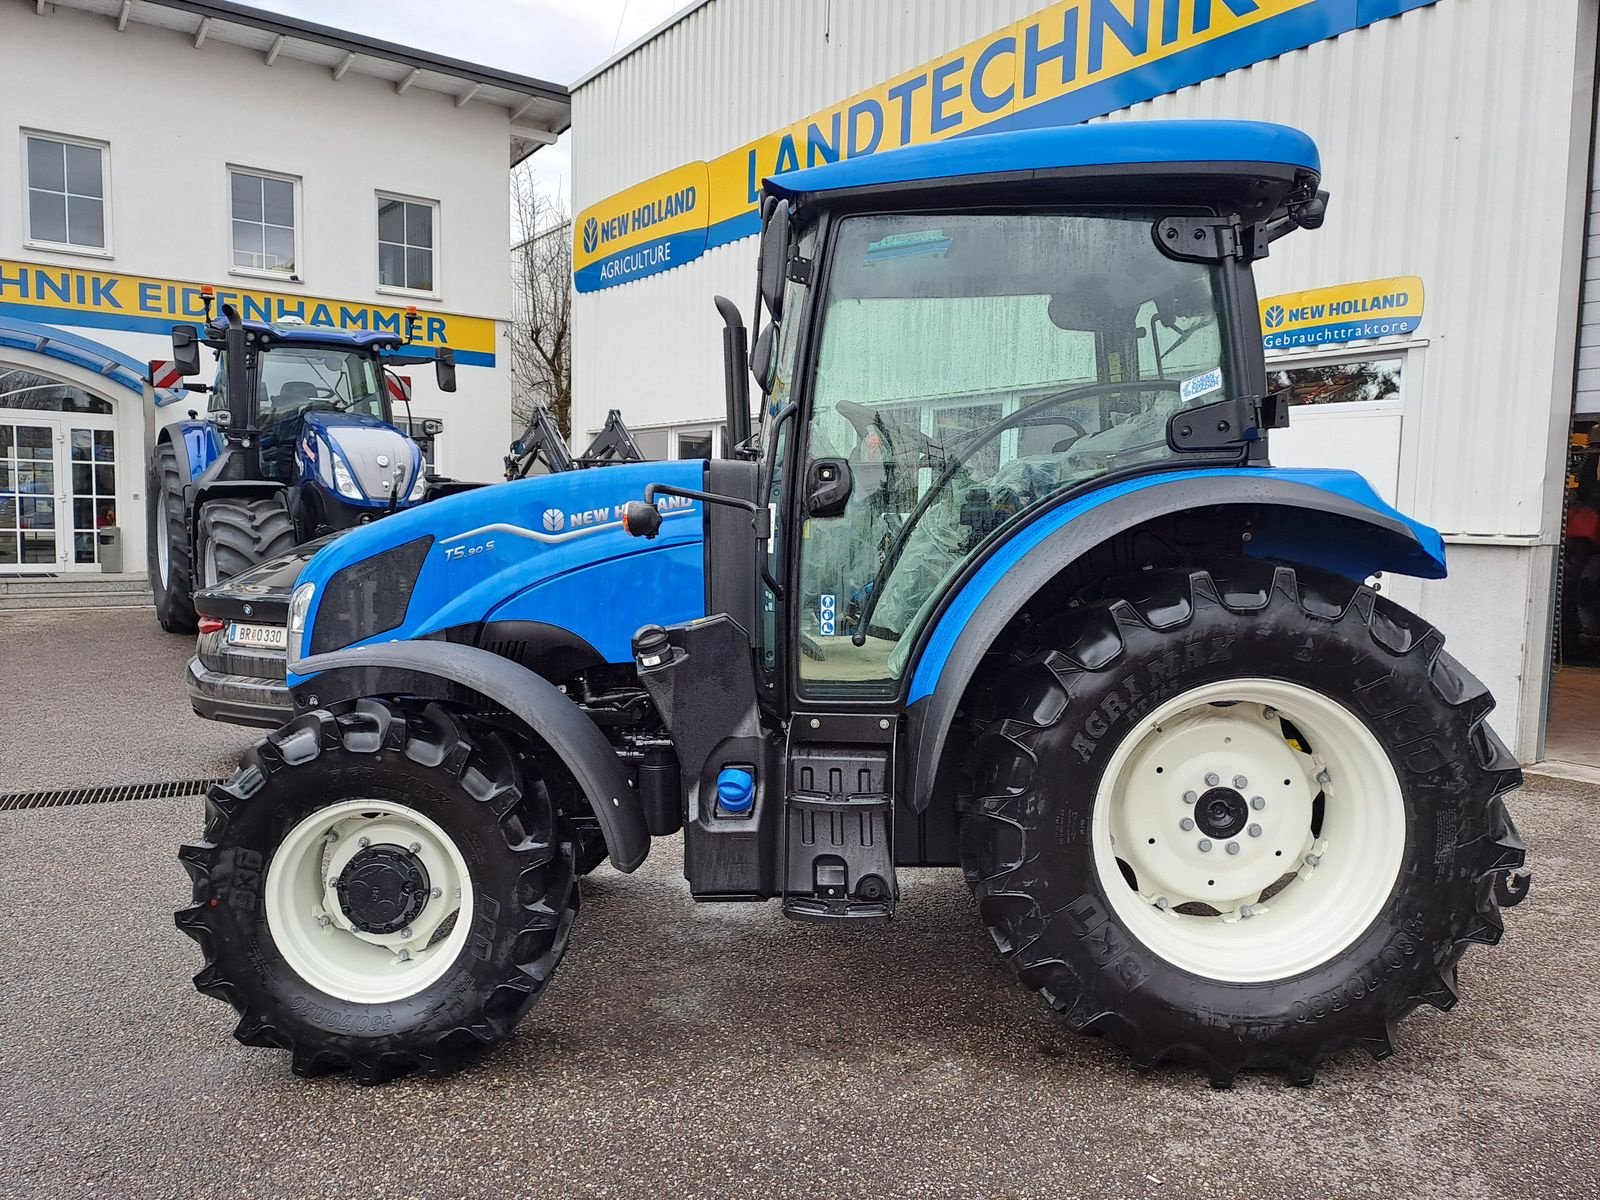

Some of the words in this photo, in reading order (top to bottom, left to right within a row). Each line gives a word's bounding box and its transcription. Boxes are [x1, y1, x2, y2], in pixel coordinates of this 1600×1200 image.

[601, 212, 630, 244] NEW
[631, 185, 697, 233] HOLLAND
[600, 242, 672, 281] AGRICULTURE
[0, 265, 123, 309] HNIK
[1288, 304, 1325, 323] NEW
[1328, 292, 1409, 317] HOLLAND
[1264, 320, 1408, 349] Gebrauchttraktore
[570, 507, 610, 528] NEW
[614, 496, 693, 519] HAND
[239, 627, 252, 640] BR
